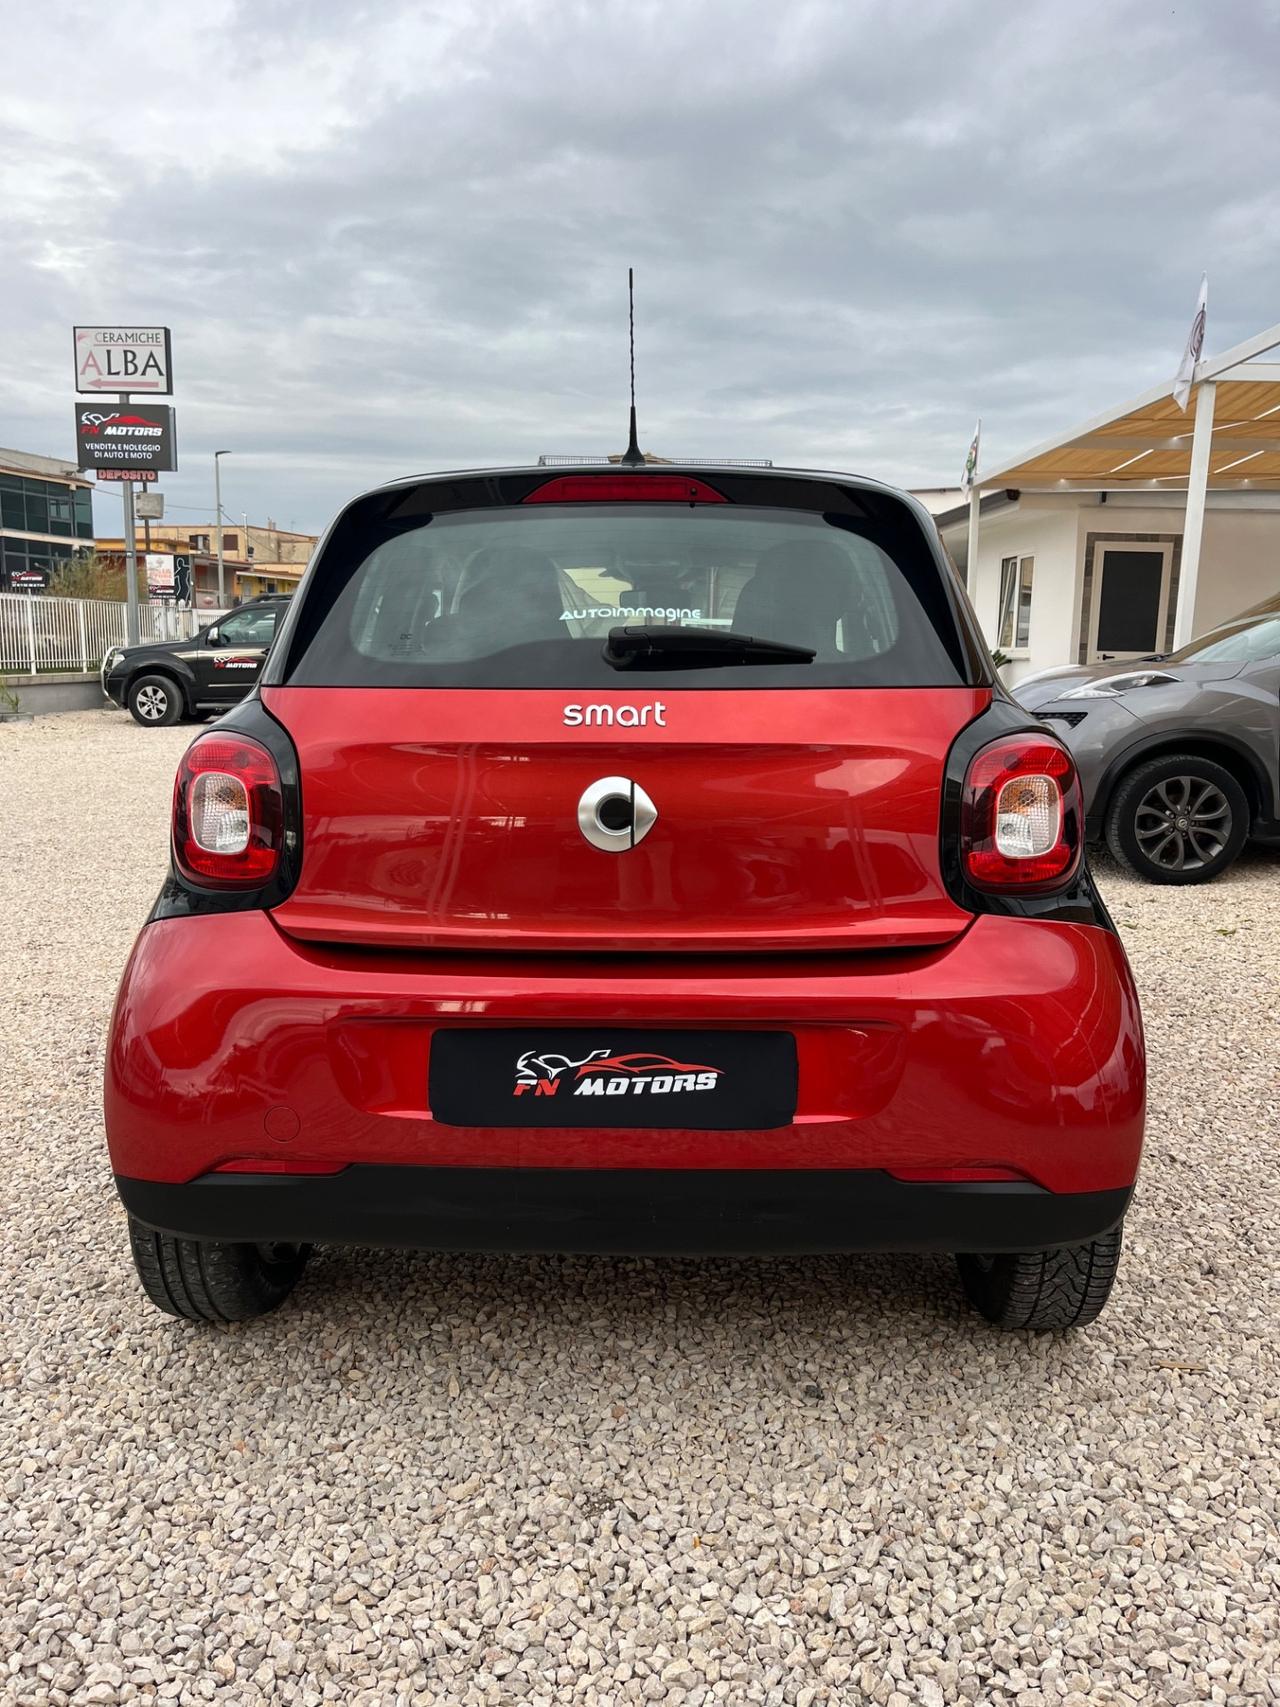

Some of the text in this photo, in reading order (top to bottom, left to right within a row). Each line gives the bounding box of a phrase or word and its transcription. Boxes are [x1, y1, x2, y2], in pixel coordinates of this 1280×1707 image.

[94, 332, 161, 344] CERAMICHE
[79, 349, 165, 376] ALBA
[104, 426, 163, 436] MOTORS
[118, 443, 122, 451] E
[123, 443, 161, 452] NOLEGGIO
[104, 451, 124, 459] AUTO
[98, 469, 156, 481] DEPOSITO
[563, 702, 667, 727] smart
[512, 1072, 718, 1096] FN MOTORS
